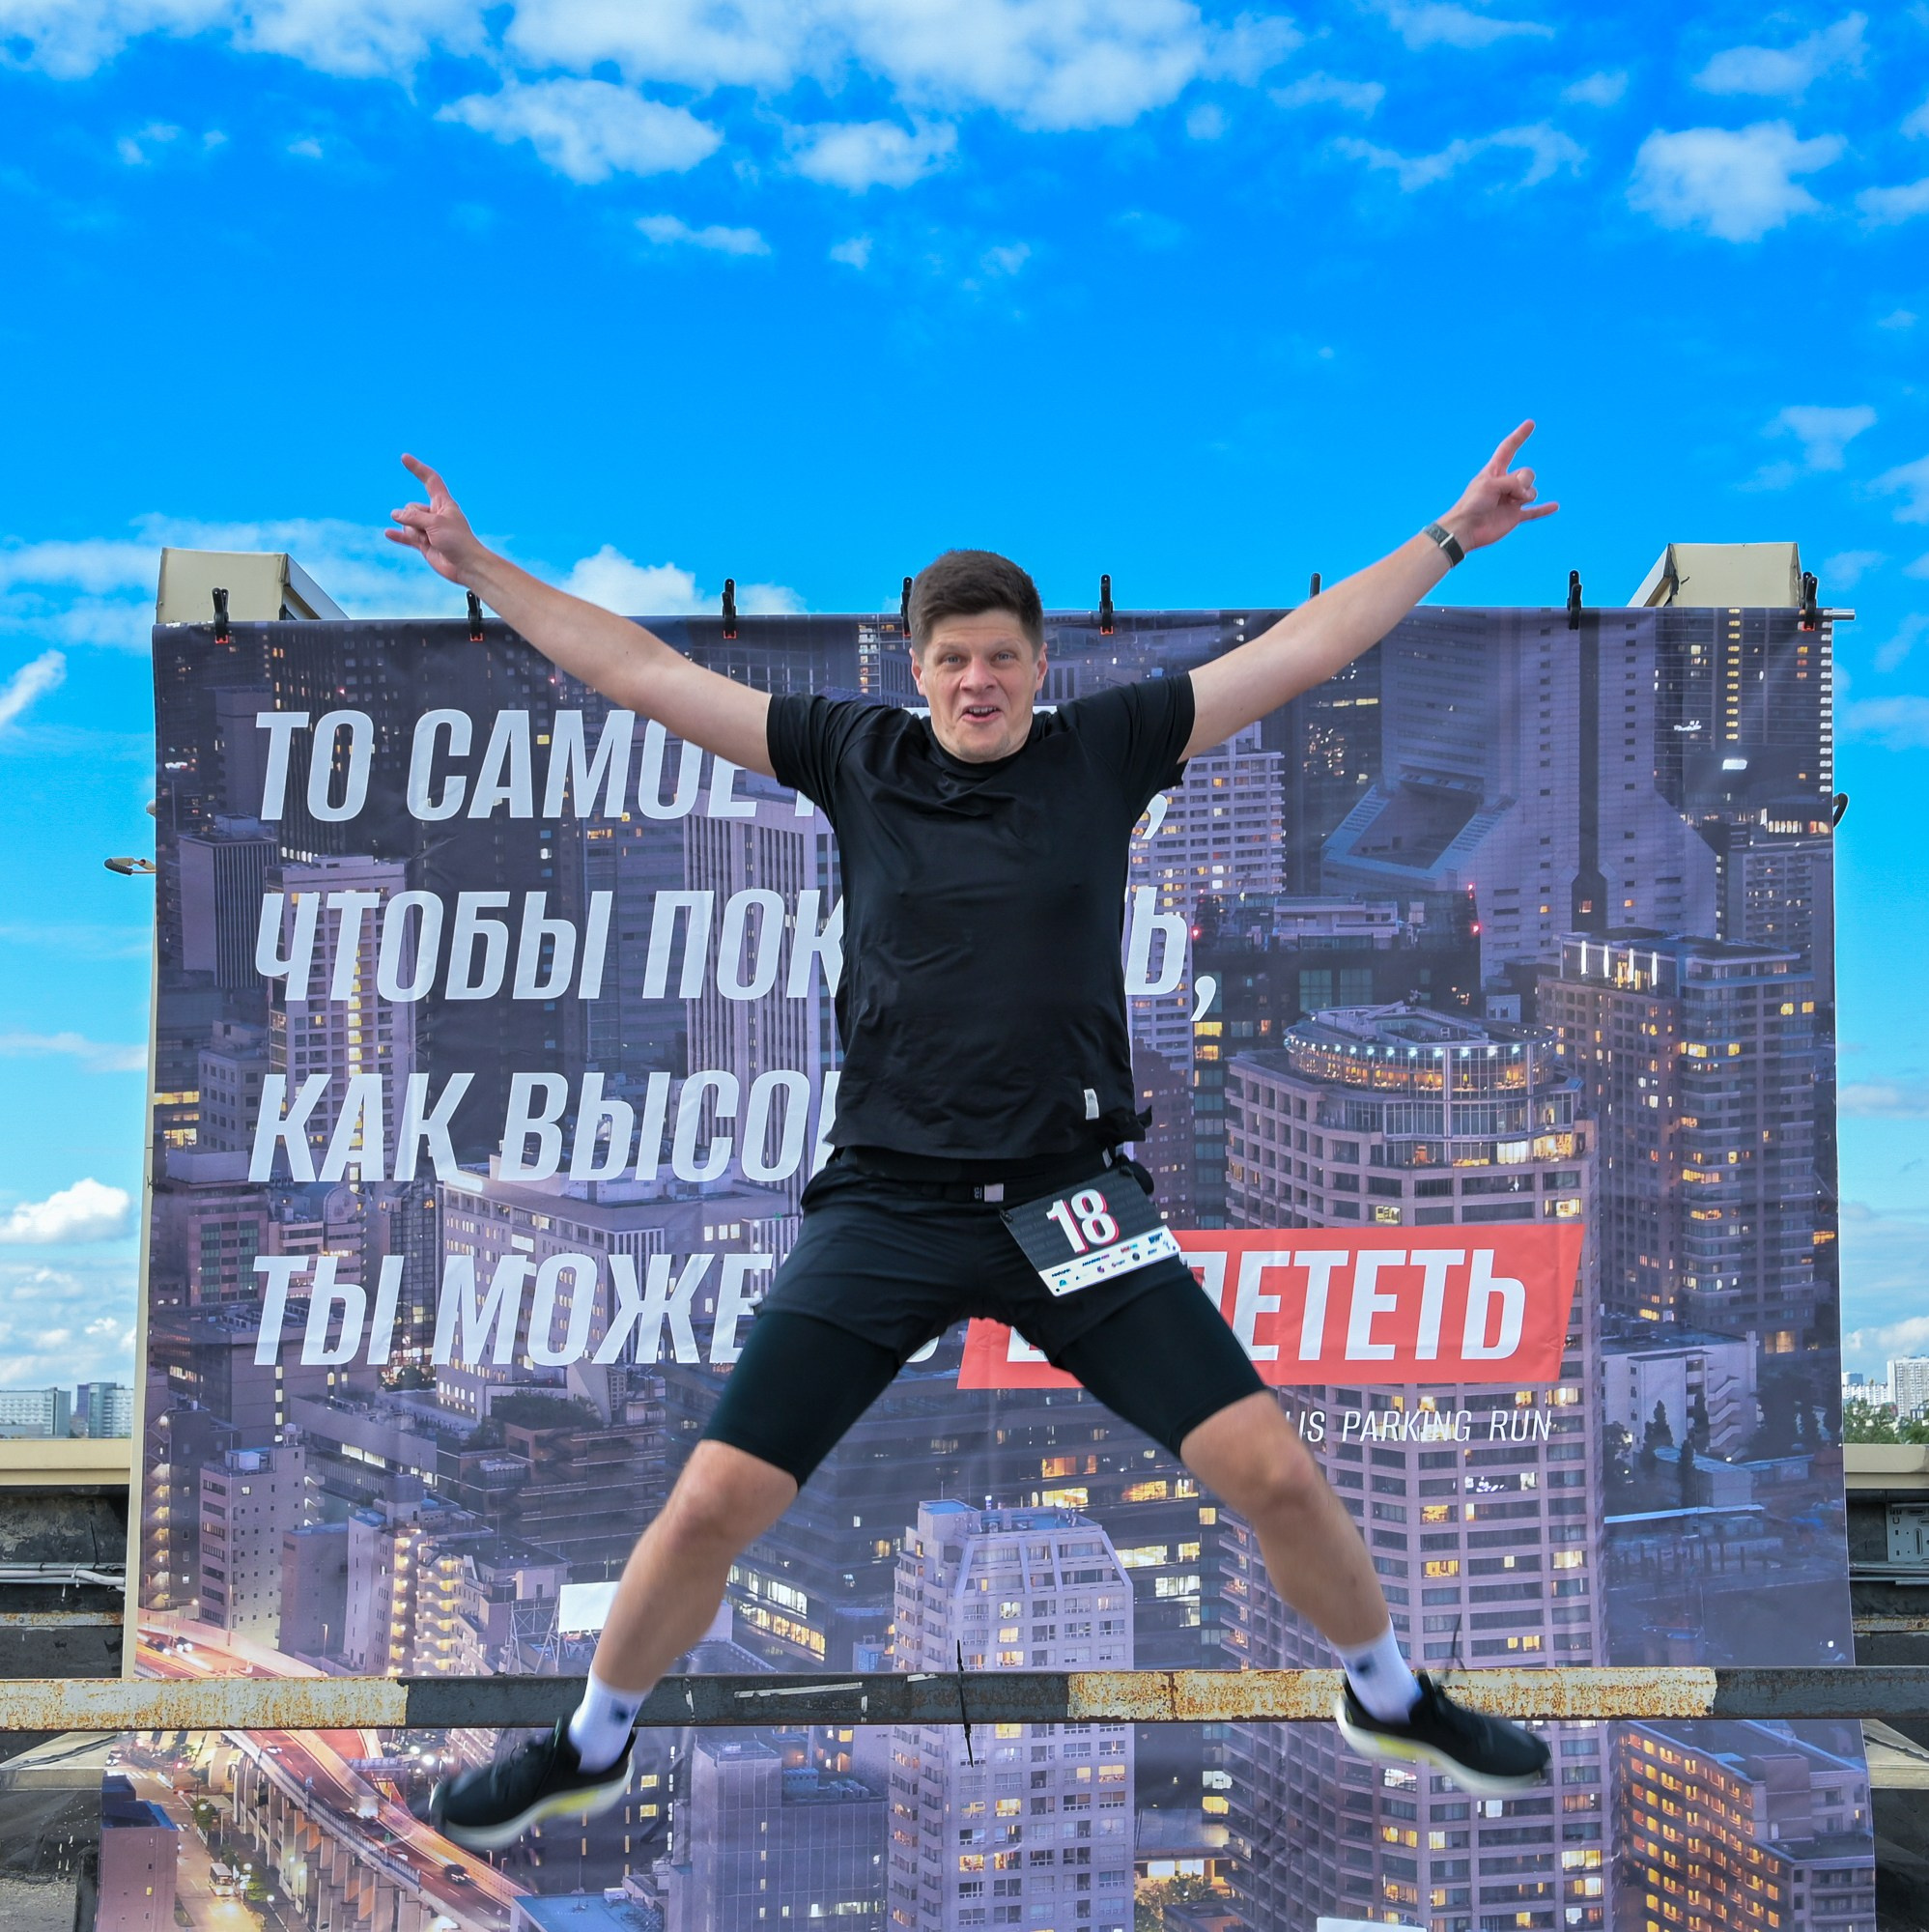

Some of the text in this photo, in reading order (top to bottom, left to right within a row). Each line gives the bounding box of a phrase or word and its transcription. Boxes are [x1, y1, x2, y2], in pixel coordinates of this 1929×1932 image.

[255, 710, 375, 821] ТО
[255, 890, 613, 1001] ЧТОБЫ
[248, 1072, 475, 1182] КАК
[1046, 1189, 1120, 1254] 18
[252, 1254, 402, 1365] ТЫ
[431, 1253, 939, 1366] МОЖЕ
[1342, 1410, 1471, 1442] PARKING
[1489, 1410, 1552, 1441] RUN
